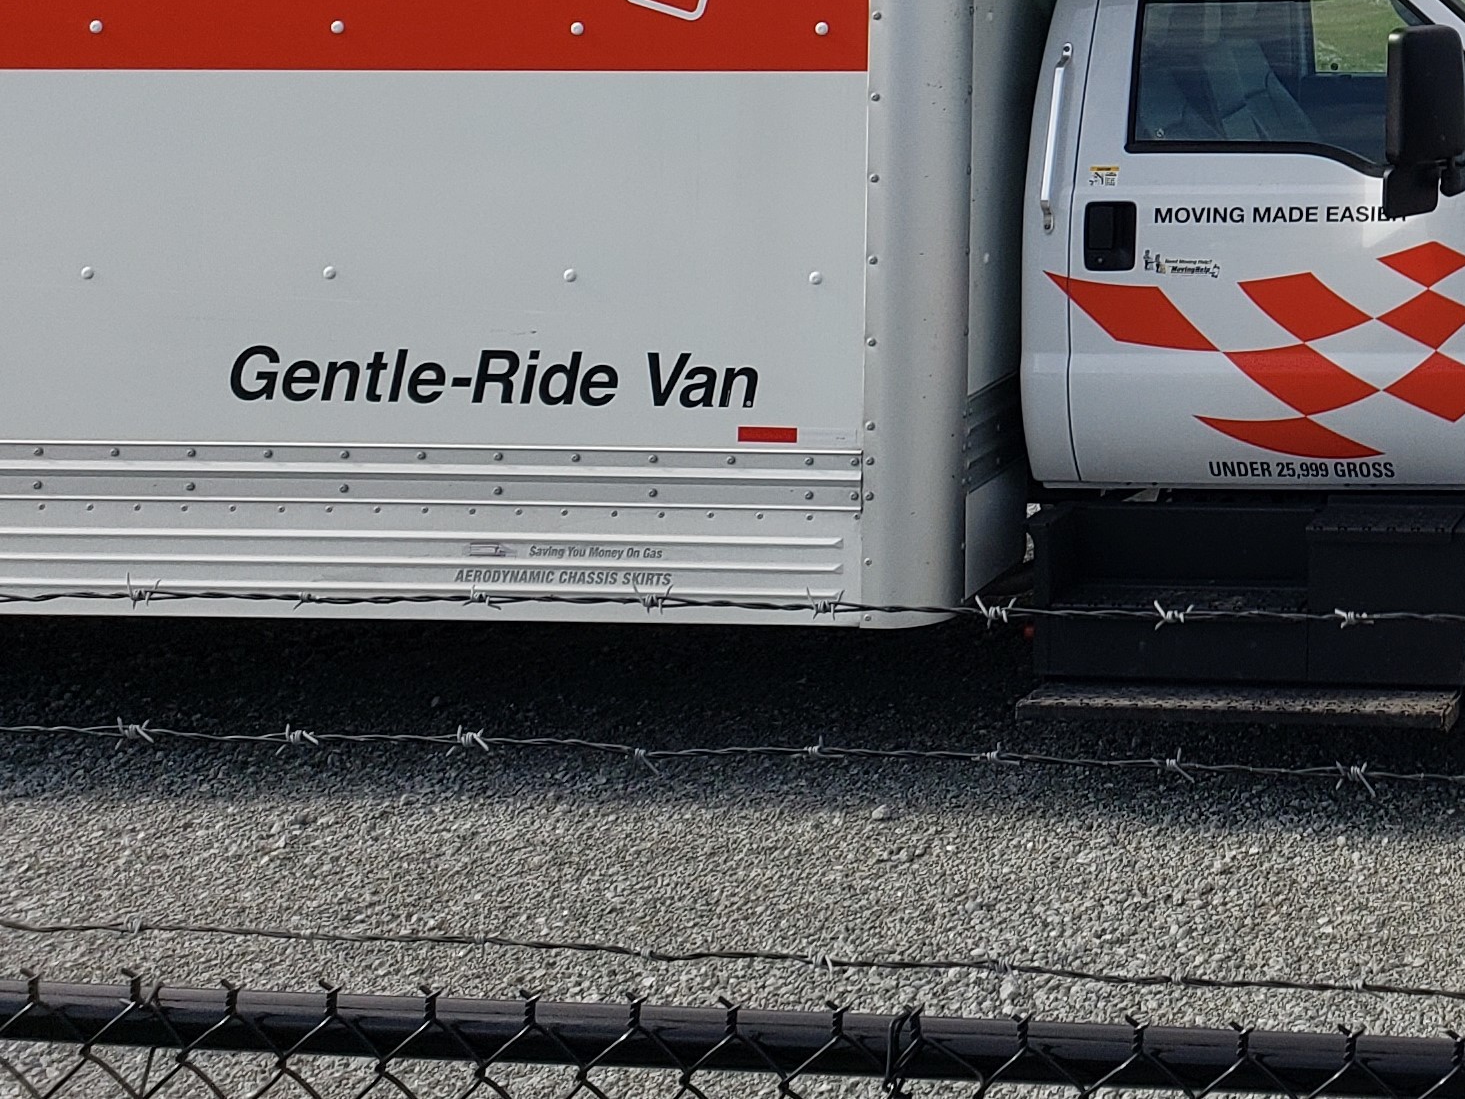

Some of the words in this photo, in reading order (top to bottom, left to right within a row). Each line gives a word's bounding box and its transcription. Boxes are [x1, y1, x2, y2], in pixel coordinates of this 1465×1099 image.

[1154, 207, 1245, 223] MOVING
[1252, 206, 1319, 223] MADE
[229, 344, 619, 407] Gentle-Ride
[646, 351, 760, 409] Van
[1208, 461, 1273, 478] UNDER
[1275, 461, 1330, 479] 25,999
[1333, 461, 1396, 479] GROSS
[528, 545, 566, 559] Saving
[567, 546, 587, 558] You
[588, 547, 624, 560] Money
[626, 547, 640, 559] On
[643, 547, 663, 559] Gas
[454, 569, 555, 584] AERODYNAMIC
[558, 571, 618, 585] CHASSIS
[621, 572, 673, 586] SKIRTS
